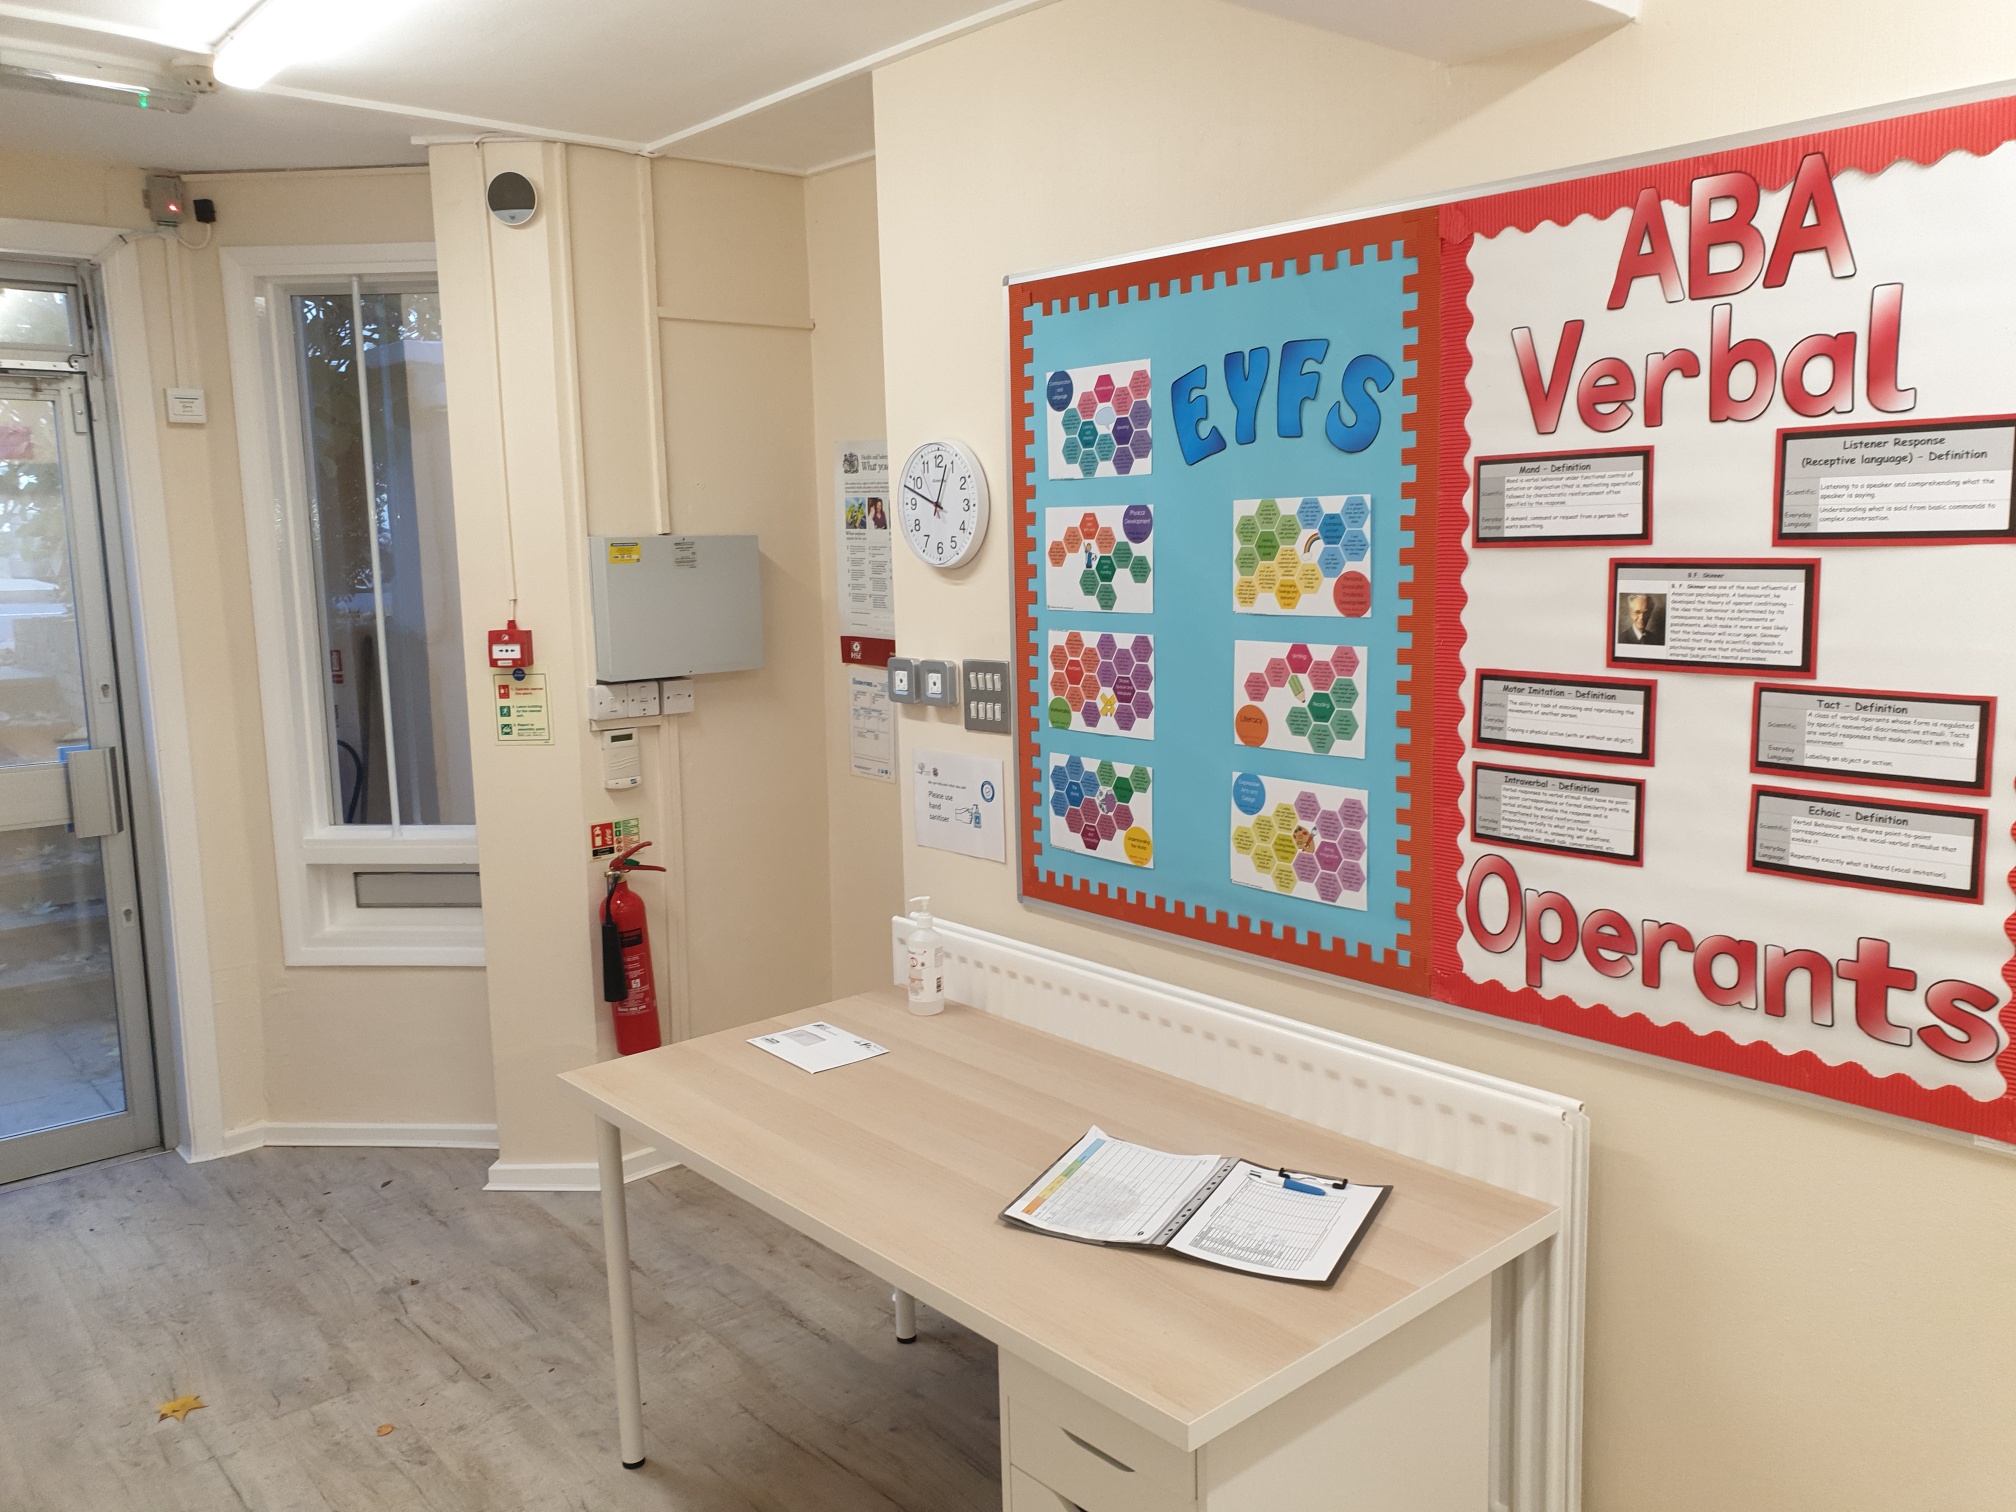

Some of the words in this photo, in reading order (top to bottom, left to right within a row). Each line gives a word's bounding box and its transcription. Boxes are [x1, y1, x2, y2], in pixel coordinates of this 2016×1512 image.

[1606, 151, 1857, 310] ABA
[1511, 282, 1917, 435] Verbal
[1171, 339, 1394, 466] EYFS
[1843, 439, 1889, 450] Listener
[1894, 437, 1946, 448] Response
[862, 461, 877, 470] What
[934, 454, 943, 468] 12
[1802, 456, 1856, 468] (Receptive
[1861, 452, 1914, 466] language)
[1929, 450, 1988, 461] Definition
[922, 460, 929, 474] 11
[951, 460, 954, 473] 1
[1519, 465, 1540, 474] Mand
[1550, 462, 1591, 472] Definition
[913, 477, 922, 489] 10
[960, 477, 966, 490] 2
[910, 498, 917, 510] 9
[963, 499, 970, 512] 3
[914, 519, 921, 532] 8
[959, 520, 966, 533] 4
[924, 534, 930, 548] 7
[950, 536, 957, 549] 5
[937, 542, 944, 555] 6
[1502, 685, 1525, 693] Motor
[1528, 687, 1564, 696] Imitation
[1575, 690, 1616, 700] Definition
[1817, 699, 1841, 709] Tact
[1855, 702, 1908, 714] Definition
[1240, 714, 1264, 725] Literacy
[1504, 776, 1548, 787] Intraverbal
[1559, 782, 1599, 793] Definition
[928, 791, 944, 800] Please
[929, 802, 941, 810] hand
[1808, 805, 1841, 818] Echoic
[1855, 812, 1908, 826] Definition
[1465, 853, 2000, 1063] Operants
